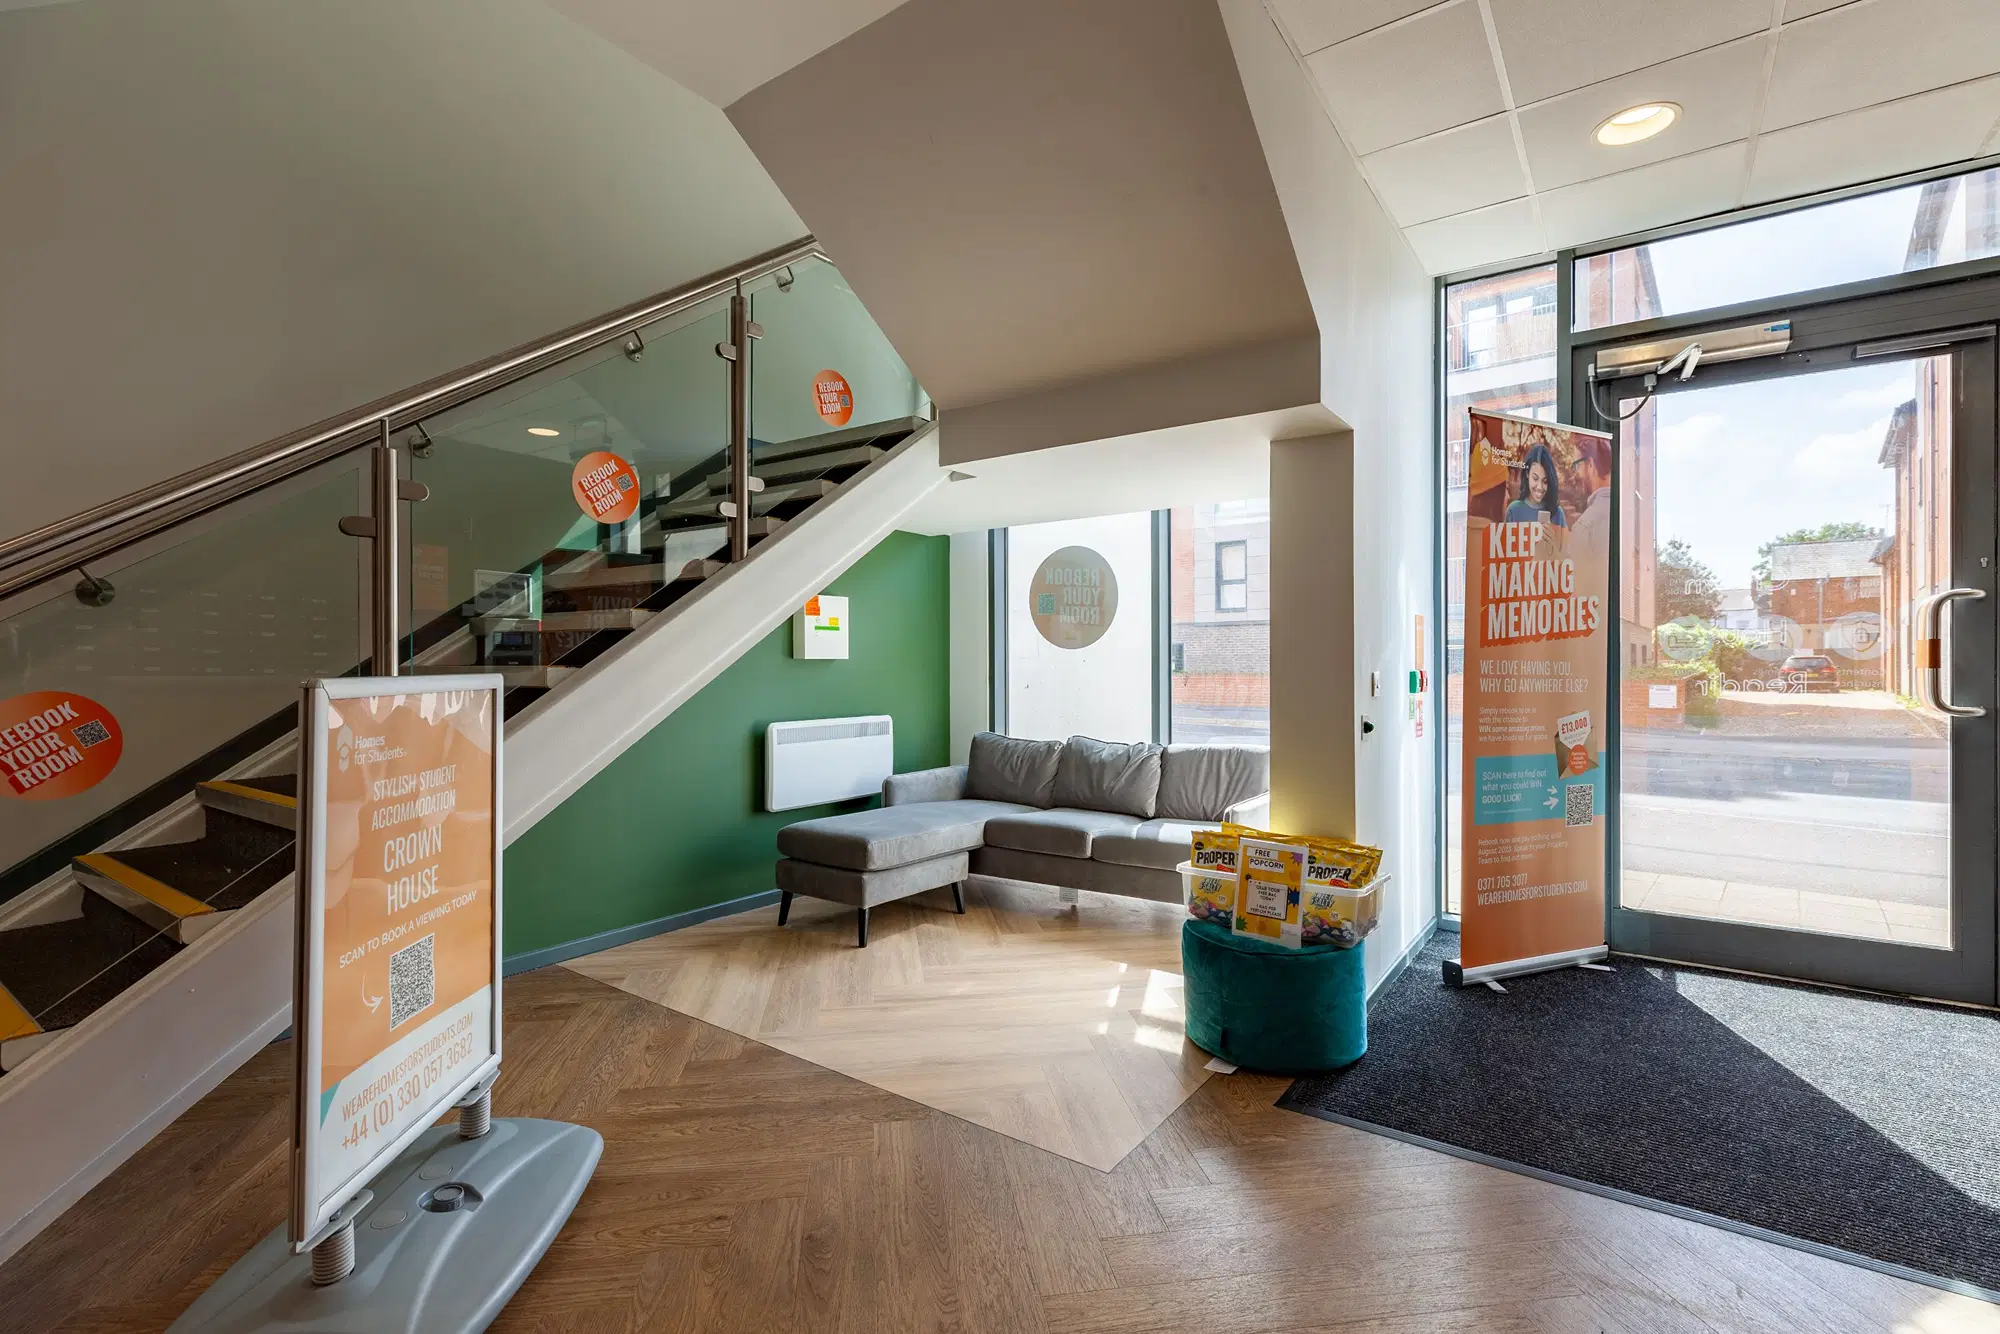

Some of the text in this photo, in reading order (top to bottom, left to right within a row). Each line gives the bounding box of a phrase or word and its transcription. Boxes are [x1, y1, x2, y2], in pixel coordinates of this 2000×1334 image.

[818, 381, 844, 393] REBOOK
[821, 392, 838, 404] YOUR
[822, 402, 842, 415] ROOM
[1491, 446, 1513, 458] Homes
[1491, 454, 1526, 469] for Students
[581, 459, 619, 491] REBOOK
[587, 478, 615, 502] YOUR
[594, 489, 624, 515] ROOM
[1489, 521, 1543, 559] KEEP
[1488, 558, 1574, 599] MAKING
[1487, 595, 1600, 640] MEMORIES
[1480, 659, 1494, 675] WE
[1496, 659, 1519, 676] LOVE
[1520, 659, 1551, 676] HAVING
[1480, 678, 1589, 693] WHY GO ANYWHERE ELSE?
[1479, 725, 1491, 733] WIN
[1561, 717, 1588, 735] £13,000
[354, 734, 386, 749] Homes
[0, 732, 67, 771] YOUR
[354, 747, 405, 765] for Students
[14, 745, 84, 789] ROOM
[1482, 771, 1502, 780] SCAN
[1502, 771, 1517, 780] here
[1517, 771, 1524, 779] to
[373, 764, 457, 801] STYLISH STUDENT
[1482, 782, 1499, 792] what
[1481, 794, 1502, 804] GOOD
[371, 788, 456, 830] ACCOMMODATION
[383, 824, 442, 873] CROWN
[1254, 849, 1271, 858] FREE
[1196, 850, 1236, 866] PROPER
[1249, 858, 1284, 869] POPCORN
[1308, 865, 1352, 881] PROPER
[387, 864, 440, 916] HOUSE
[1477, 877, 1495, 891] 0371
[1496, 875, 1511, 889] 705
[1477, 880, 1588, 906] WEAREHOMESFORSTUDENTS.COM
[1250, 907, 1282, 918] PERSON PLEASE
[339, 888, 478, 969] SCAN TO BOOK A VIEWING TODAY
[342, 1012, 473, 1122] WEAREHOMESFORSTUDENTS.COM
[341, 1033, 473, 1149] +44 (0) 330 057 3682
